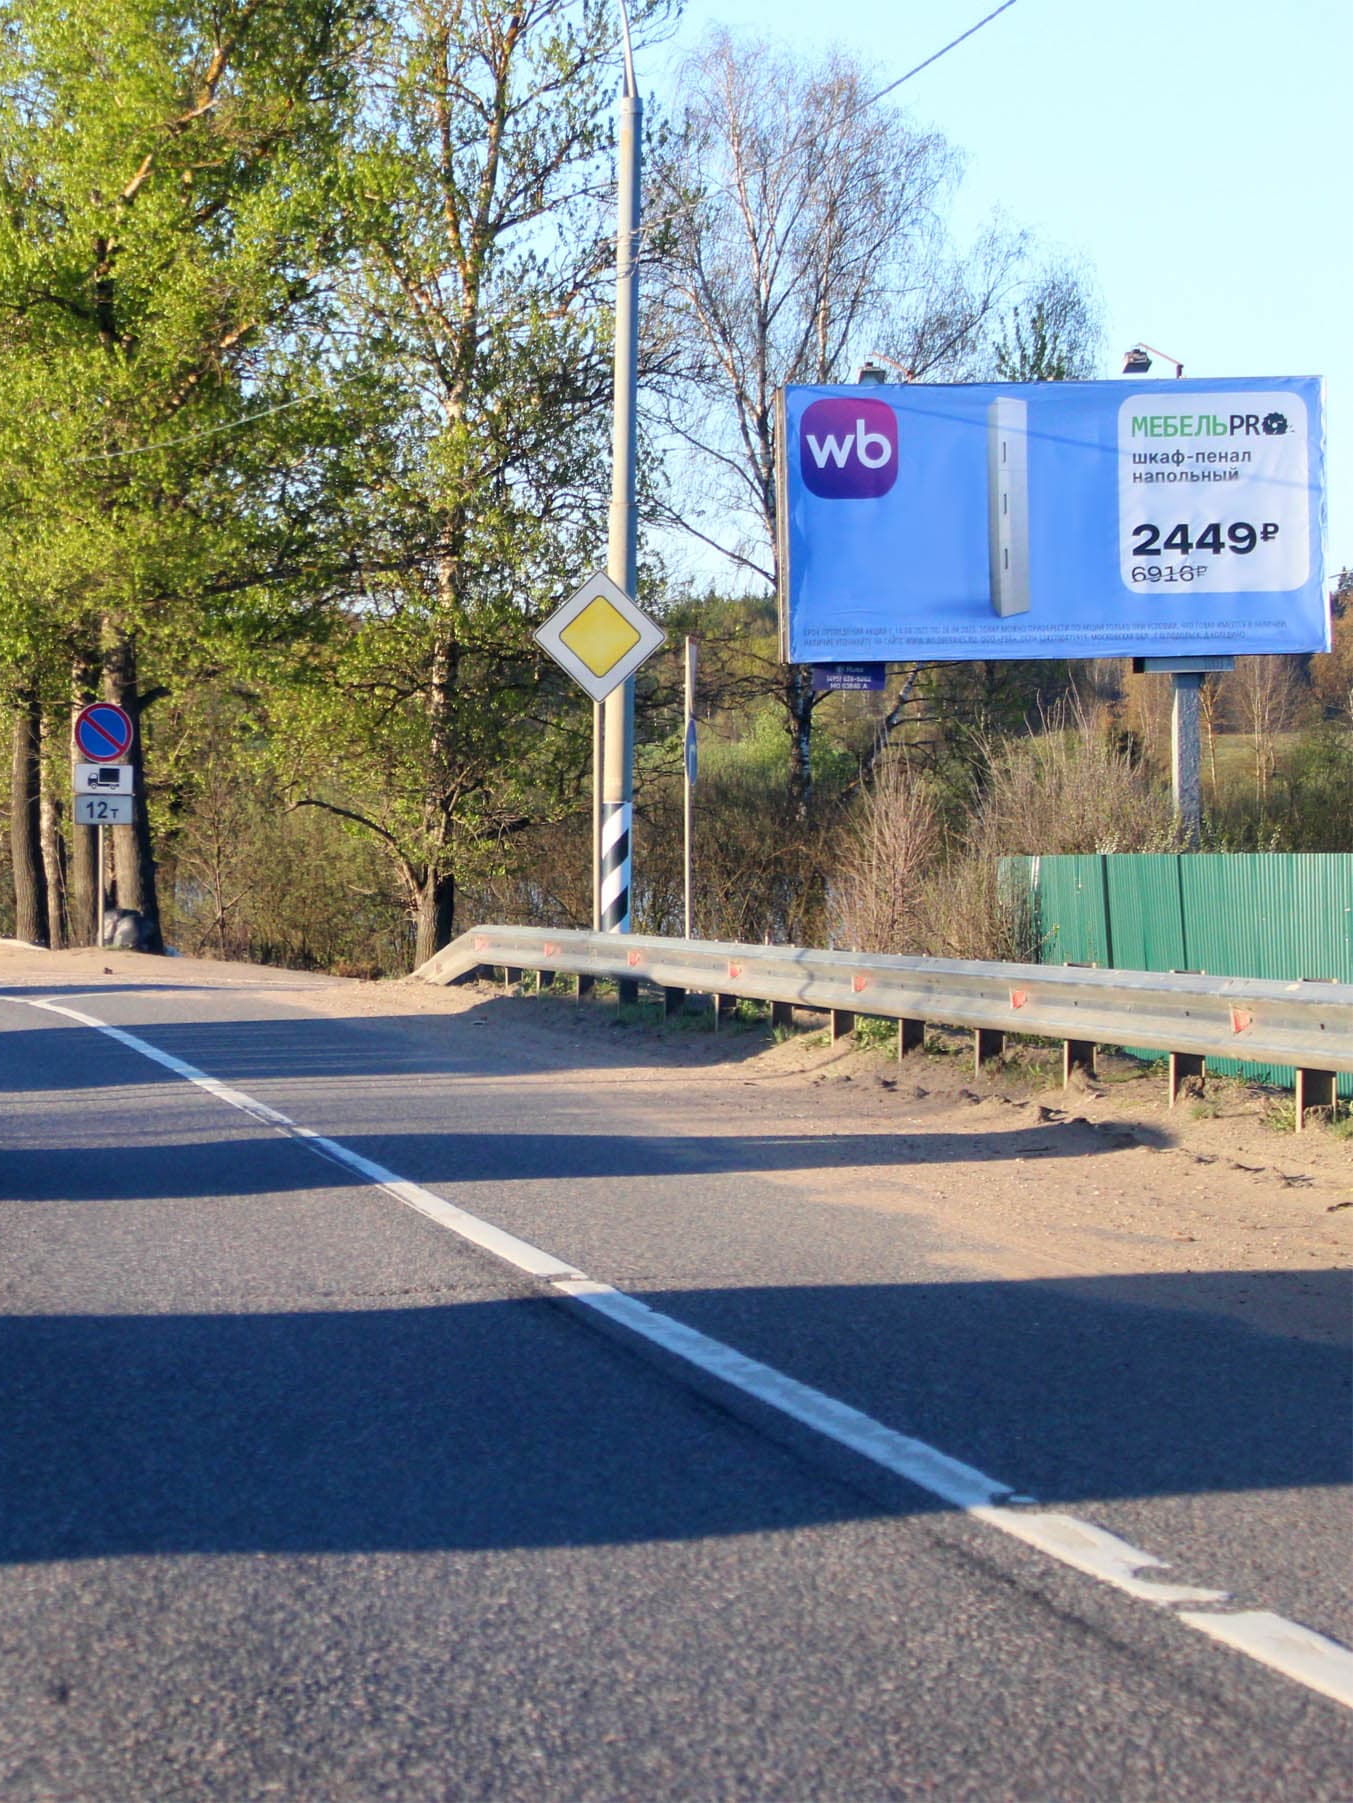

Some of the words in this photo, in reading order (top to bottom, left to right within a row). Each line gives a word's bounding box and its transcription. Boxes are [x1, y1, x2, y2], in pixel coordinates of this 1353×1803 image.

[806, 418, 892, 469] wb
[1132, 449, 1252, 467] шкаф-пенал
[1132, 467, 1240, 484] напольный
